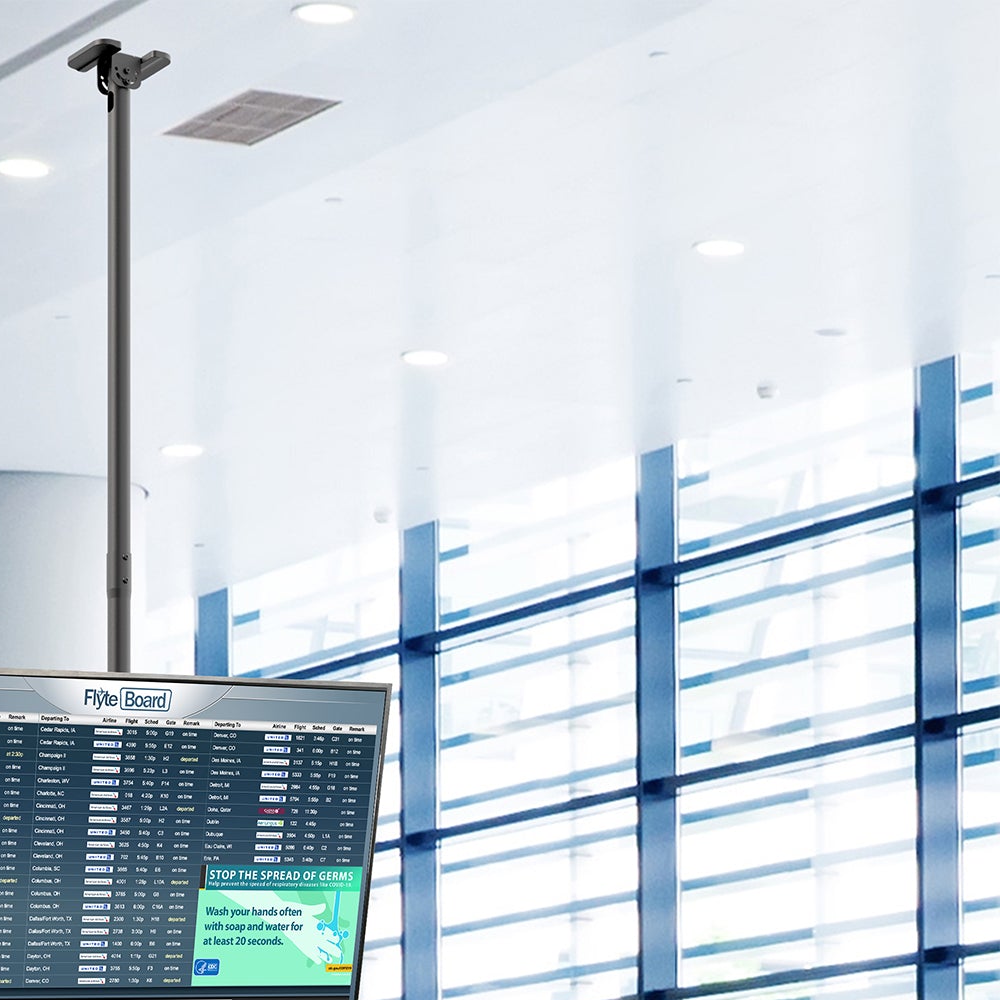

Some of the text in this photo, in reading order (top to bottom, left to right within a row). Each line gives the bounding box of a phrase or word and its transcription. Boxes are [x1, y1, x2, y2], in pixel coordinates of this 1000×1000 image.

[83, 687, 167, 711] Flyte Board
[209, 870, 354, 881] STOP THE SPREAD OF GERMS
[205, 906, 303, 919] Wash your hands often
[204, 921, 304, 933] with soap and water for
[203, 936, 284, 946] at least 20 seconds.
